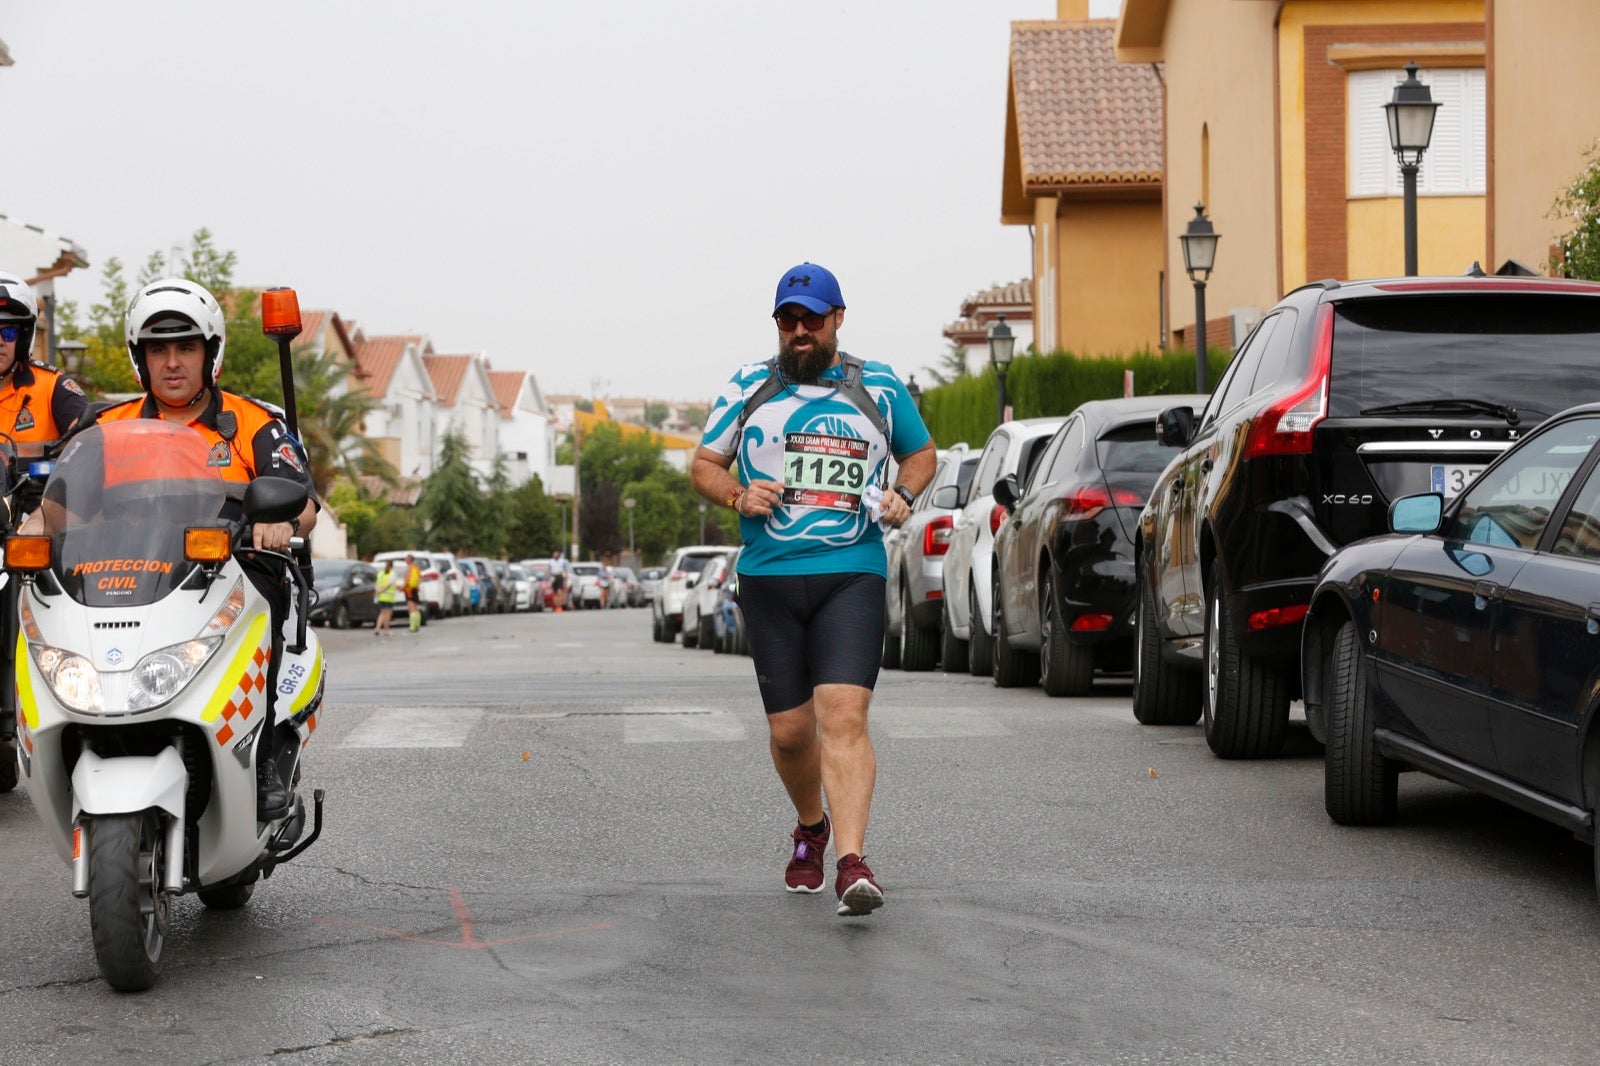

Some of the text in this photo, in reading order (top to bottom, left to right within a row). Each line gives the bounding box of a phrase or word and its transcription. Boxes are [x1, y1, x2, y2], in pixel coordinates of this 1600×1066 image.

[805, 436, 820, 446] GRAN
[821, 437, 840, 448] PREMIO
[841, 440, 848, 448] DE
[848, 441, 865, 450] FONDO
[790, 456, 864, 489] 1129
[72, 559, 173, 576] PROTECCION
[97, 576, 138, 590] CIVIL
[278, 664, 305, 695] GR-25
